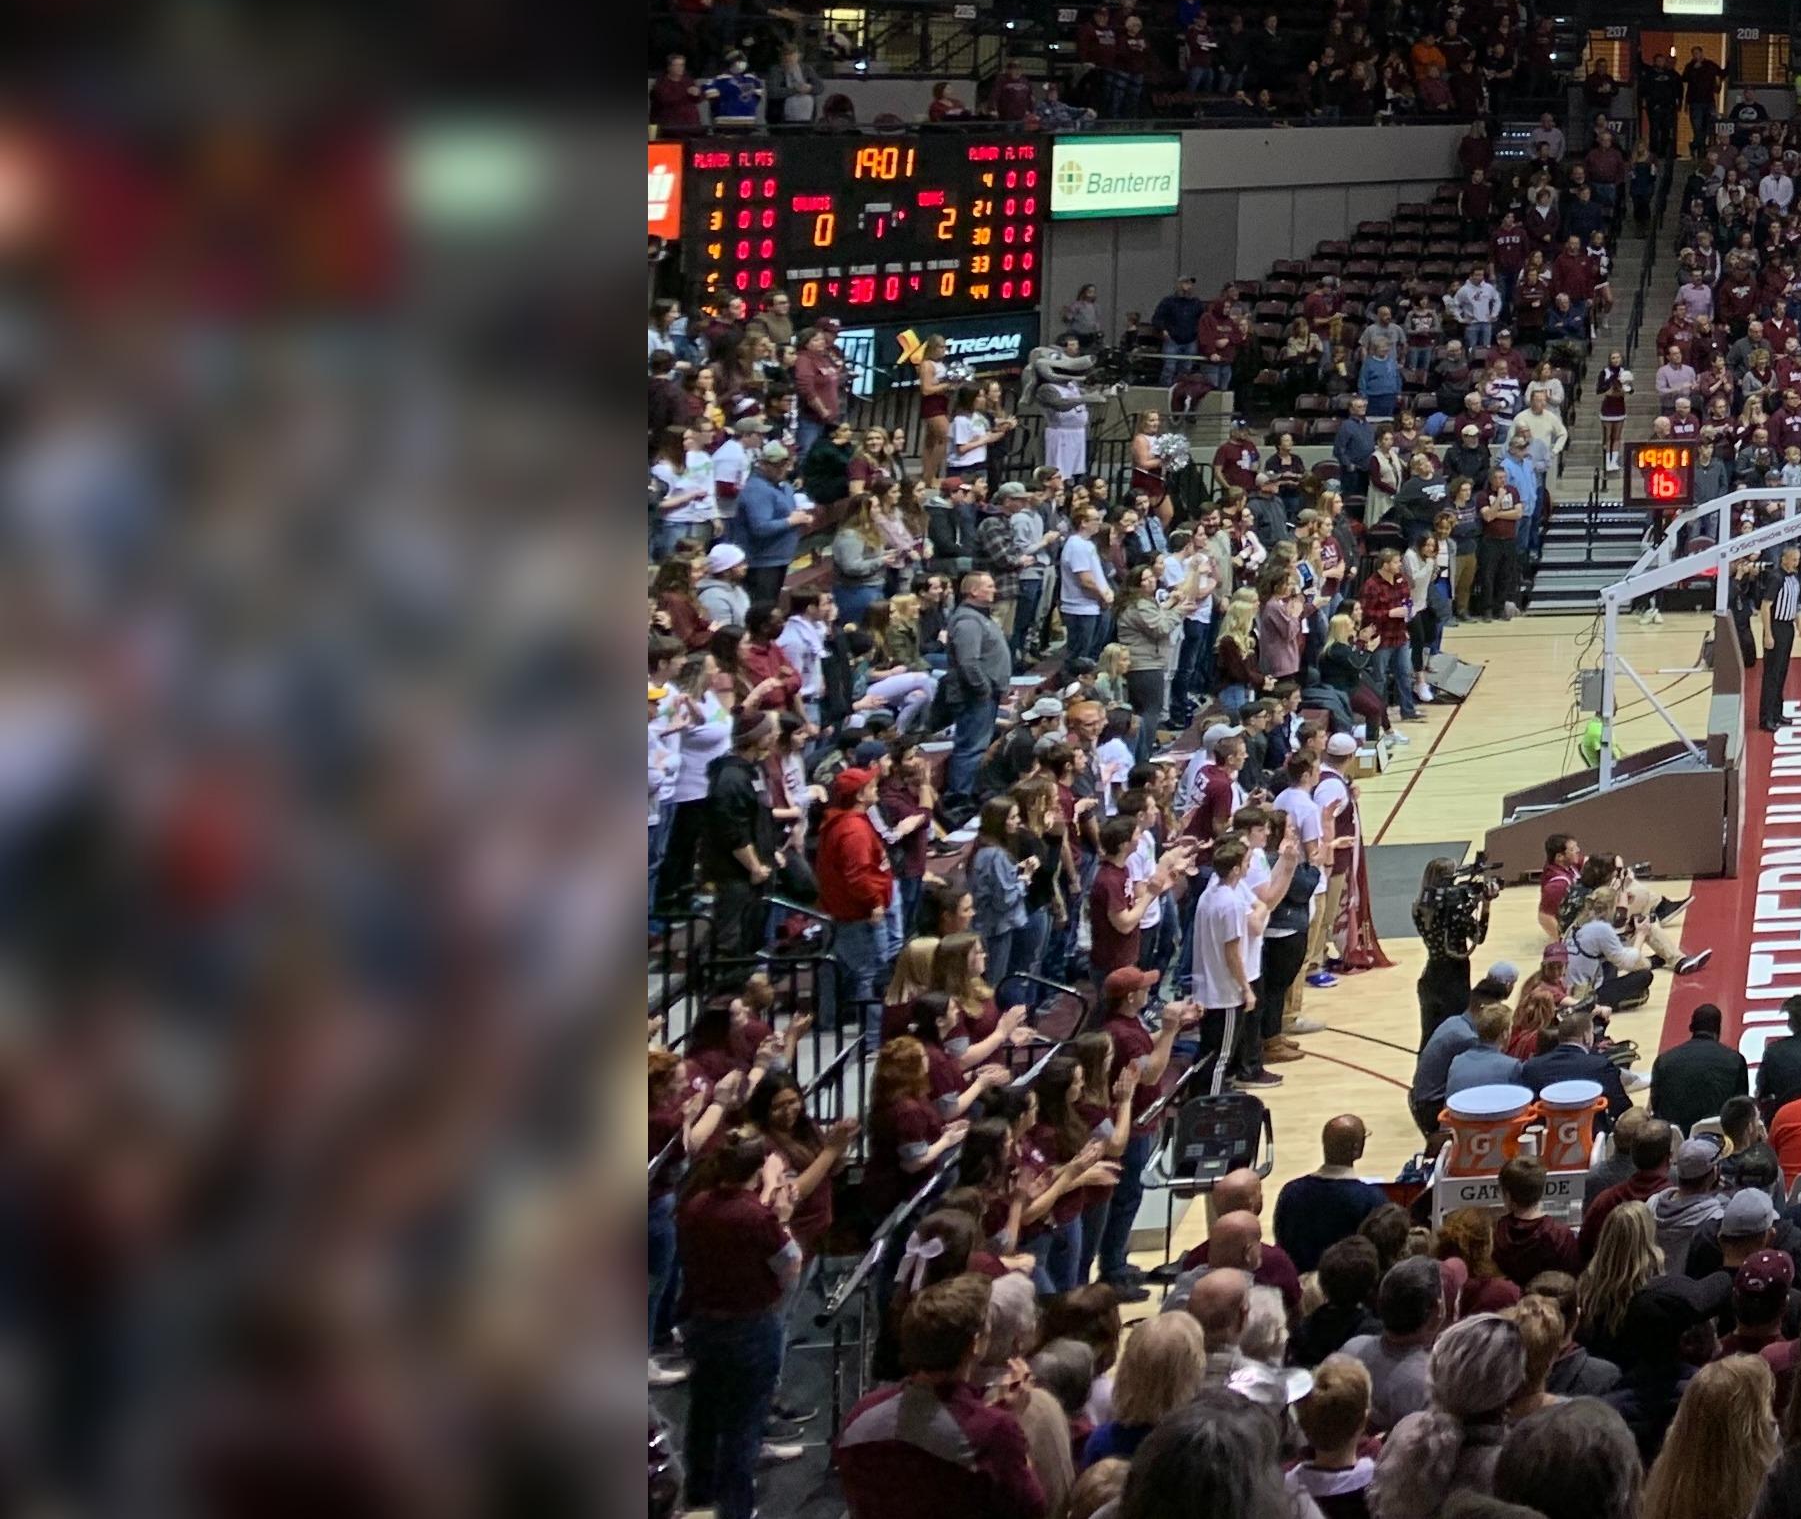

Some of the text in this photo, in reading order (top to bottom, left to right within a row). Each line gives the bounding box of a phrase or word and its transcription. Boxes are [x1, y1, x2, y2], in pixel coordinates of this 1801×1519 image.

[755, 148, 775, 167] PTS
[855, 147, 914, 179] 19:01
[1019, 146, 1034, 159] PTS
[1086, 171, 1172, 195] Banterra
[972, 199, 992, 218] 21
[814, 213, 835, 247] 0
[938, 207, 957, 239] 2
[972, 227, 992, 246] 30
[970, 255, 990, 274] 33
[849, 278, 875, 304] 30
[969, 284, 989, 300] 44
[1639, 449, 1688, 468] 19:01
[1653, 473, 1674, 497] 16
[1558, 1122, 1578, 1143] G
[1470, 1134, 1491, 1154] G
[1460, 1180, 1570, 1201] GATDE
